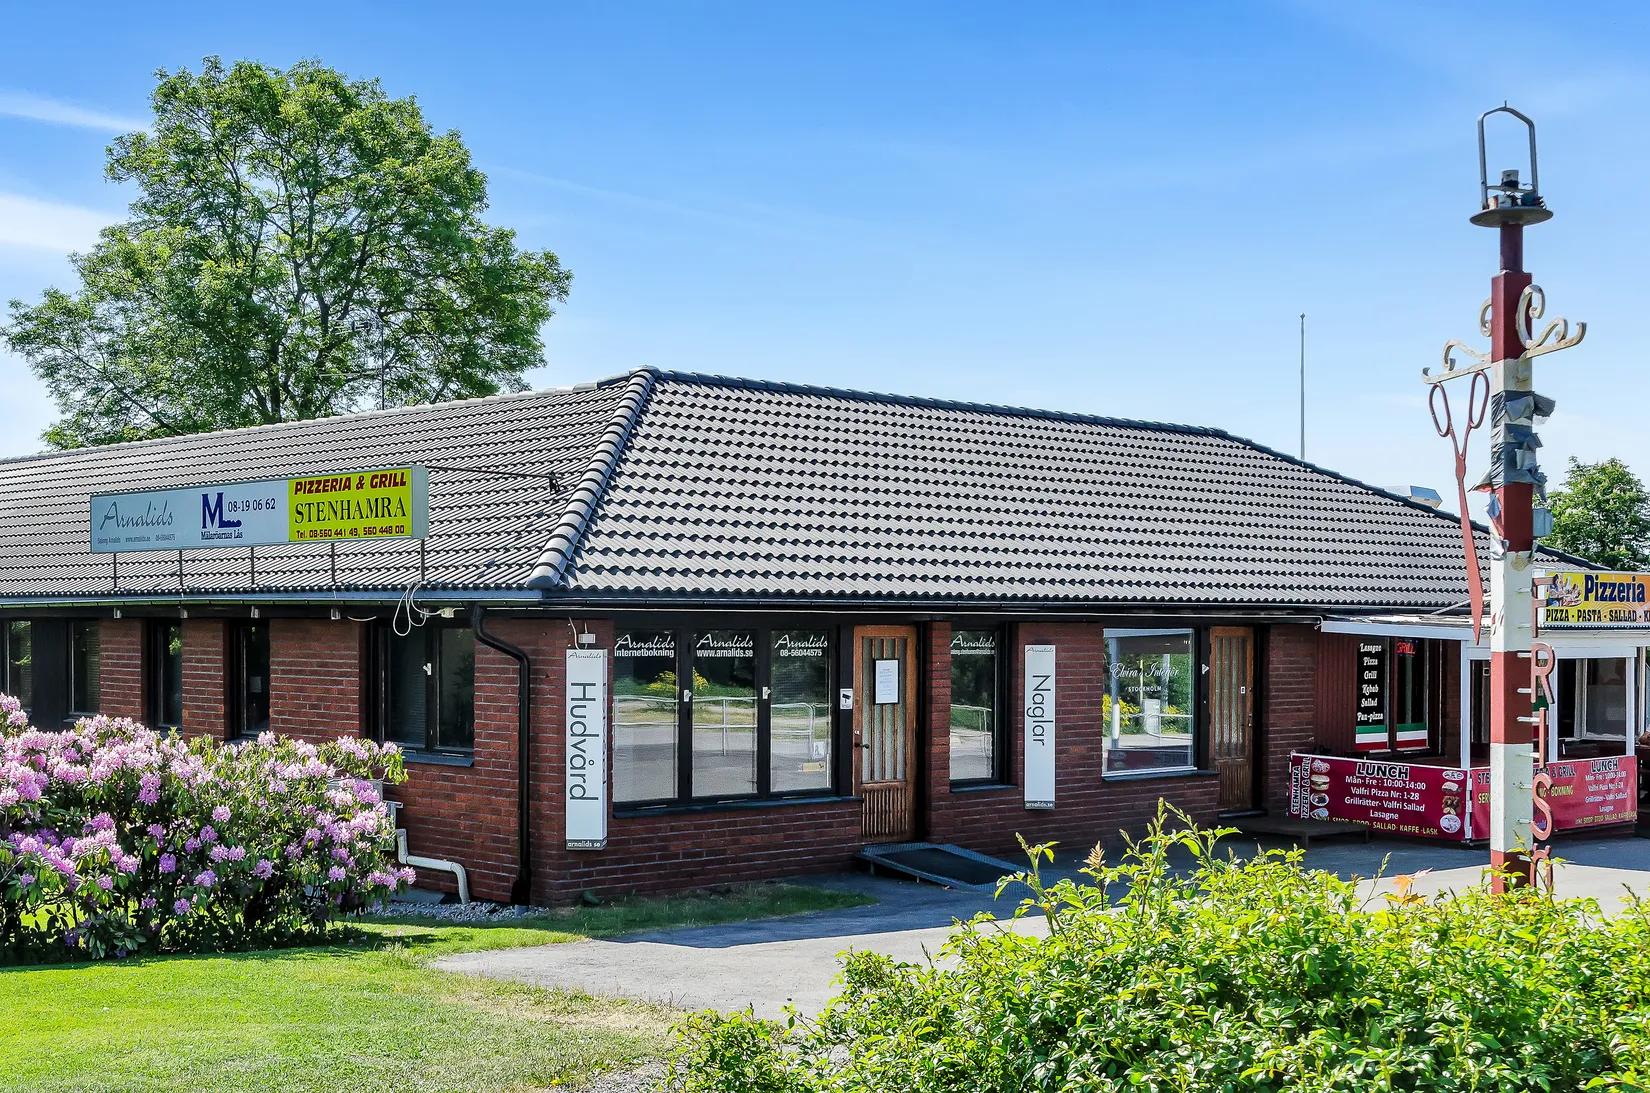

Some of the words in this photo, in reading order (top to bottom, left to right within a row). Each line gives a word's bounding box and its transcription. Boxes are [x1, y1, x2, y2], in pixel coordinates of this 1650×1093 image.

[294, 477, 351, 495] PIZZERIA
[356, 475, 365, 490] &
[370, 472, 407, 489] GRILL
[228, 500, 250, 513] 08-19
[252, 499, 263, 512] 06
[265, 498, 276, 511] 62
[294, 496, 407, 524] STENHAMRA
[100, 500, 174, 531] Arnalids
[233, 529, 244, 539] Lås
[296, 530, 308, 539] Tel.
[309, 529, 332, 538] 08-560
[334, 528, 346, 537] 441
[363, 526, 377, 536] 560
[379, 525, 393, 535] 448
[395, 525, 405, 534] 00
[1584, 574, 1646, 603] Pizzeria
[1546, 609, 1569, 622] PIZZA
[1577, 609, 1601, 622] PASTA
[1609, 609, 1637, 622] SALLAD
[614, 634, 675, 649] Arnalids
[696, 633, 753, 648] Arnalids
[774, 634, 828, 649] Arnalids
[950, 634, 996, 648] Arnalids
[568, 651, 602, 659] Arnalids
[614, 648, 675, 658] internetbokning
[696, 648, 754, 658] www.arnalids.se
[780, 649, 822, 657] 08-56044575
[1360, 643, 1382, 653] Lasagne
[1363, 656, 1378, 666] Pizza
[1364, 671, 1377, 679] Grill
[1128, 685, 1162, 693] STOCKHOLM
[1362, 684, 1379, 696] Kebab
[1361, 698, 1378, 707] Sallad
[1026, 675, 1054, 746] Naglar
[1357, 712, 1384, 722] Pan-pizza
[569, 682, 600, 801] Hudvård
[1302, 756, 1312, 778] GRILL
[1356, 763, 1410, 780] LUNCH
[1552, 767, 1558, 778] &
[1559, 764, 1576, 778] GRILL
[1591, 758, 1619, 773] LUNCH
[1302, 778, 1311, 787] &
[1345, 775, 1365, 784] Mån-
[1383, 779, 1426, 791] 10:00-14:00
[1291, 765, 1301, 815] STENHAMRA
[1351, 786, 1370, 796] Valfri
[1371, 788, 1389, 798] Pizza
[1391, 789, 1402, 799] Nr:
[1403, 791, 1420, 801] 1-28
[1344, 797, 1382, 808] Grillrätter-
[1383, 800, 1402, 809] Valfri
[1403, 801, 1425, 812] Sallad
[1370, 810, 1399, 820] Lasagne
[1399, 824, 1419, 833] KAFFE
